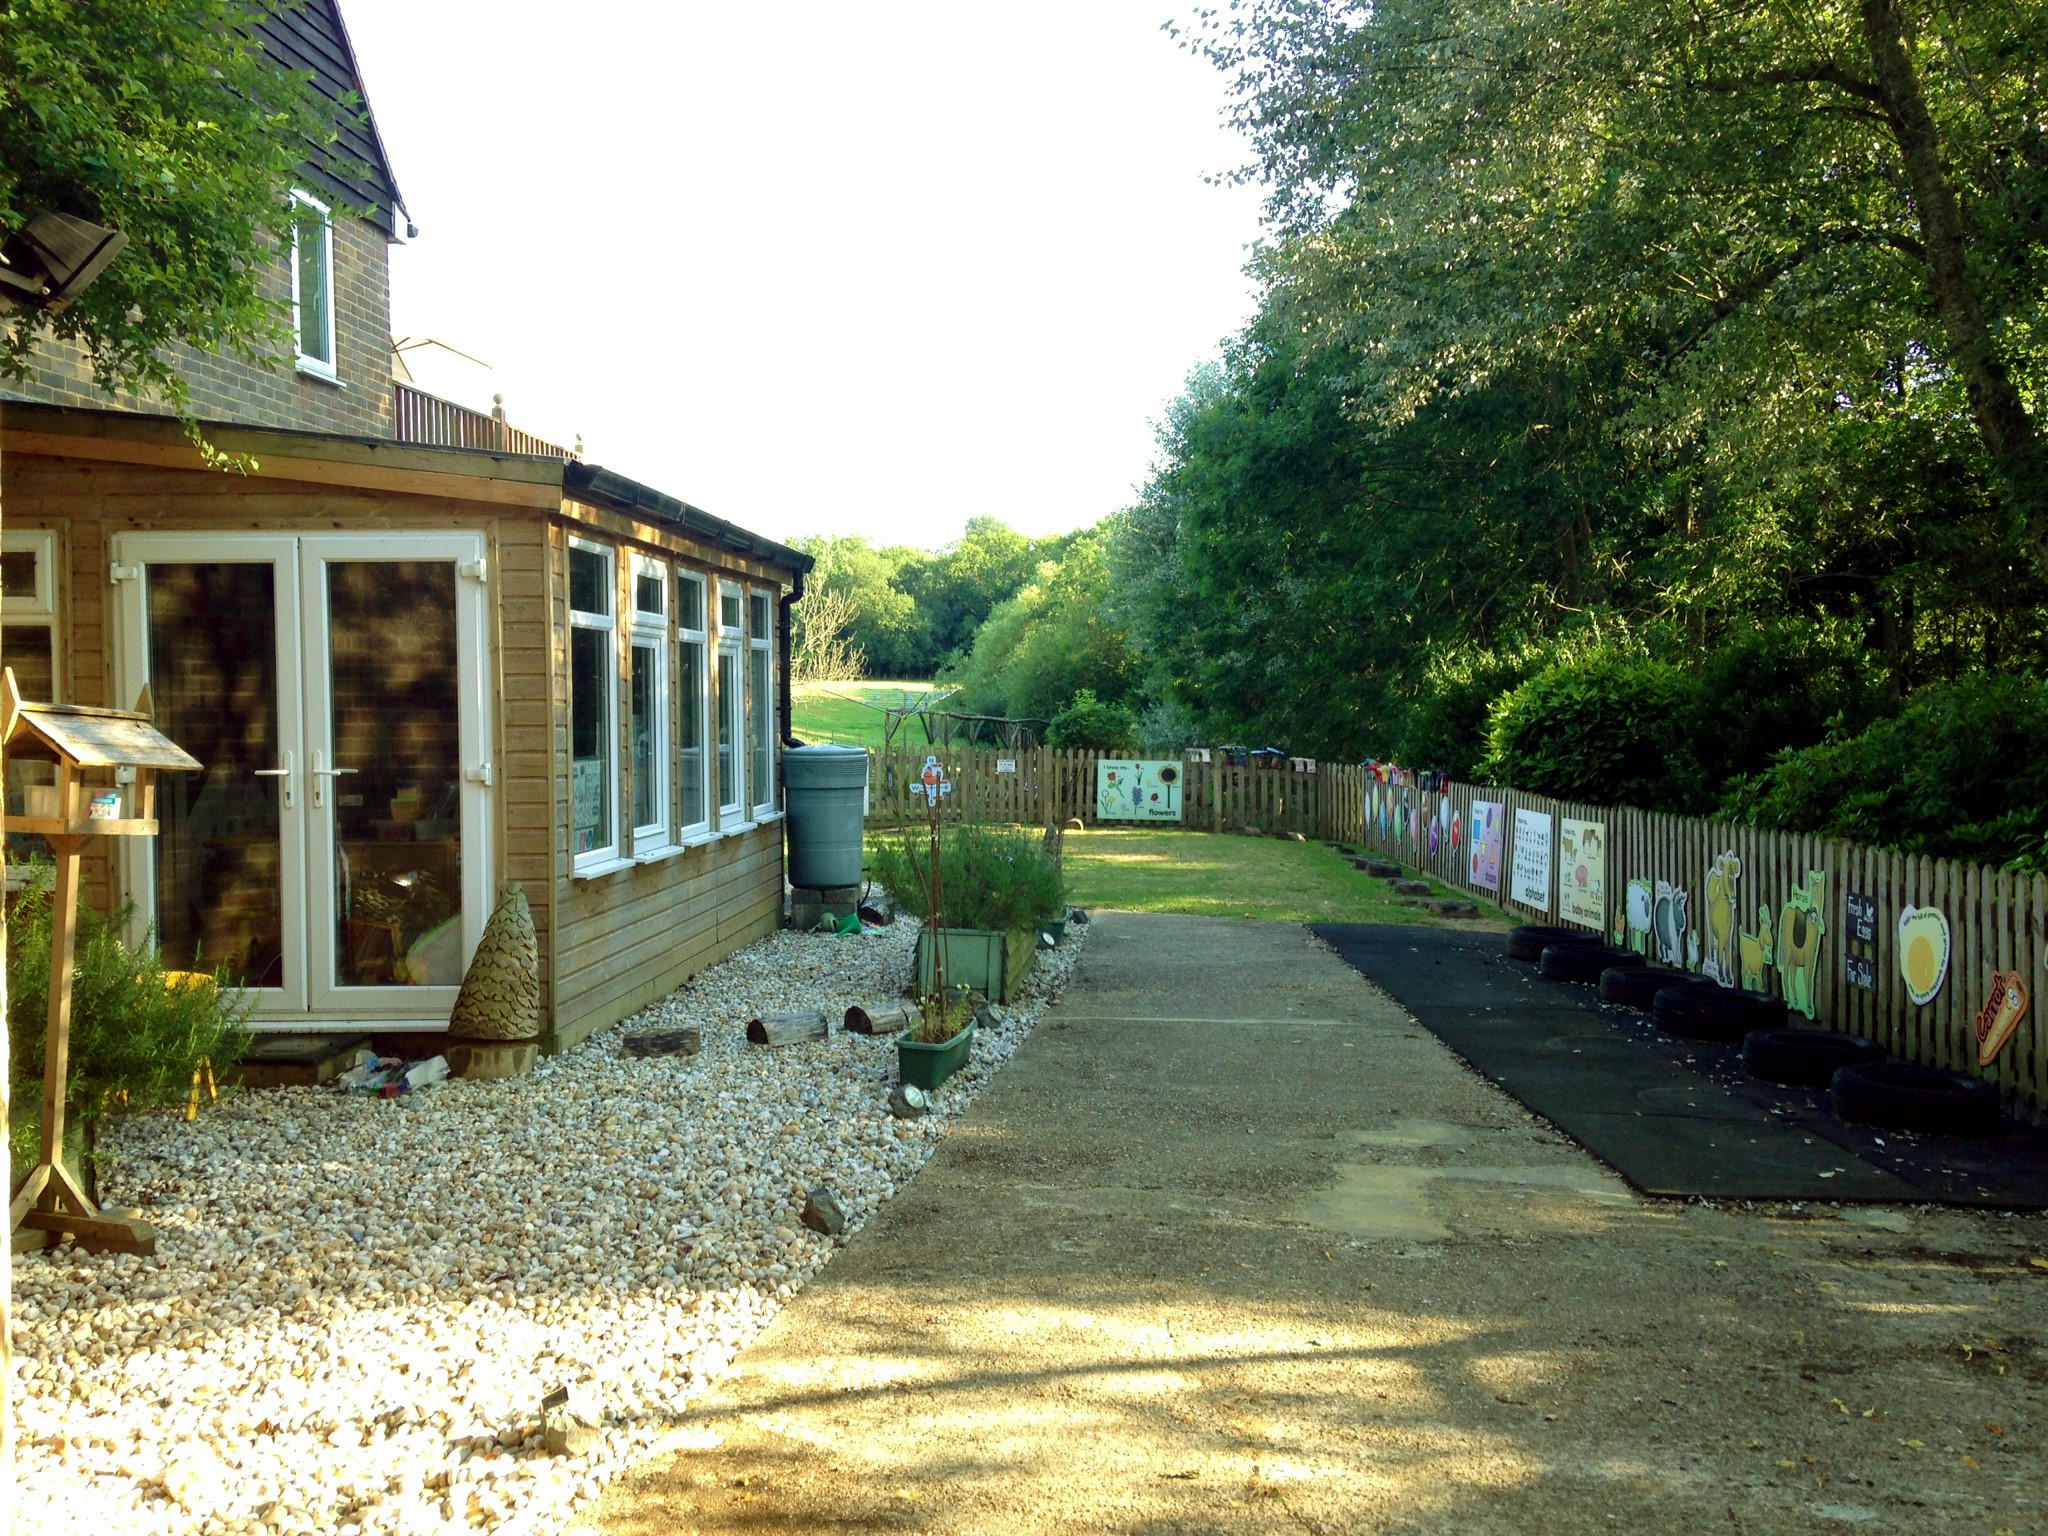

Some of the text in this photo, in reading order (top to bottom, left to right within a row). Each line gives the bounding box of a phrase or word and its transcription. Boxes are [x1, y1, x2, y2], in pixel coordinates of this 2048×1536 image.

[1148, 808, 1176, 816] flowers
[1525, 885, 1545, 903] alphabet
[1572, 903, 1601, 922] baby animals
[1847, 896, 1862, 917] Fresh
[1857, 918, 1872, 941] Eggs
[1847, 959, 1873, 989] For Sale
[1976, 974, 2006, 1043] Carrot
